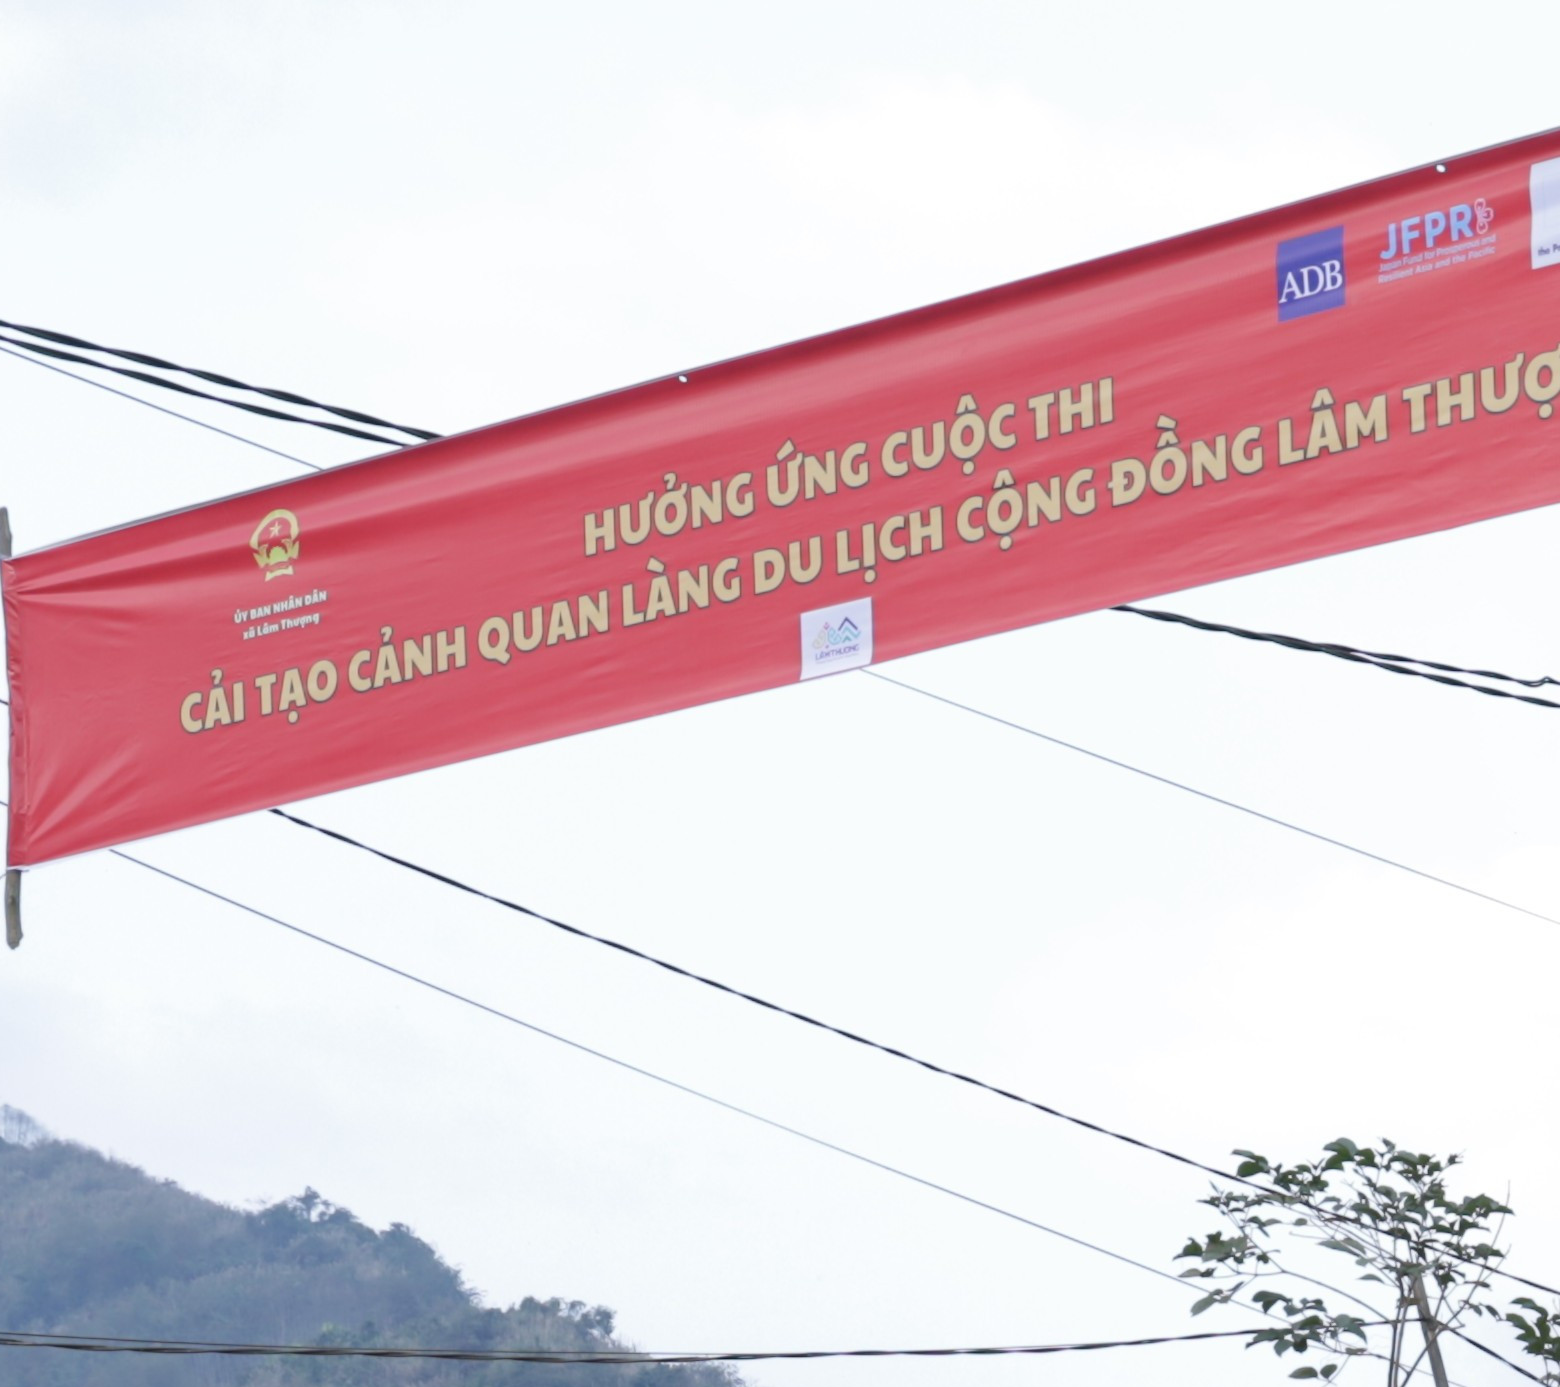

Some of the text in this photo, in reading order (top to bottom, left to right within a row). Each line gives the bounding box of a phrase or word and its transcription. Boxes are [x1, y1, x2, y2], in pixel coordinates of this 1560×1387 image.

[1380, 204, 1474, 260] JFPR
[1538, 245, 1551, 257] the
[1278, 259, 1343, 304] ADB
[583, 376, 1114, 556] HƯỞNG ỨNG CUỘC THI
[180, 667, 246, 733] CẢI
[255, 659, 338, 724] TẠO
[348, 625, 467, 692] CẢNH
[477, 589, 609, 665] QUAN
[622, 556, 741, 627] LÀNG
[753, 535, 822, 595] DU
[835, 505, 943, 583] LỊCH
[956, 468, 1096, 551] CỘNG
[1107, 415, 1263, 507] ĐỒNG
[1277, 387, 1388, 466] LÂM
[234, 589, 327, 624] ỦY BAN NHÂN DÂN
[243, 613, 320, 640] xã Lâm Thượng
